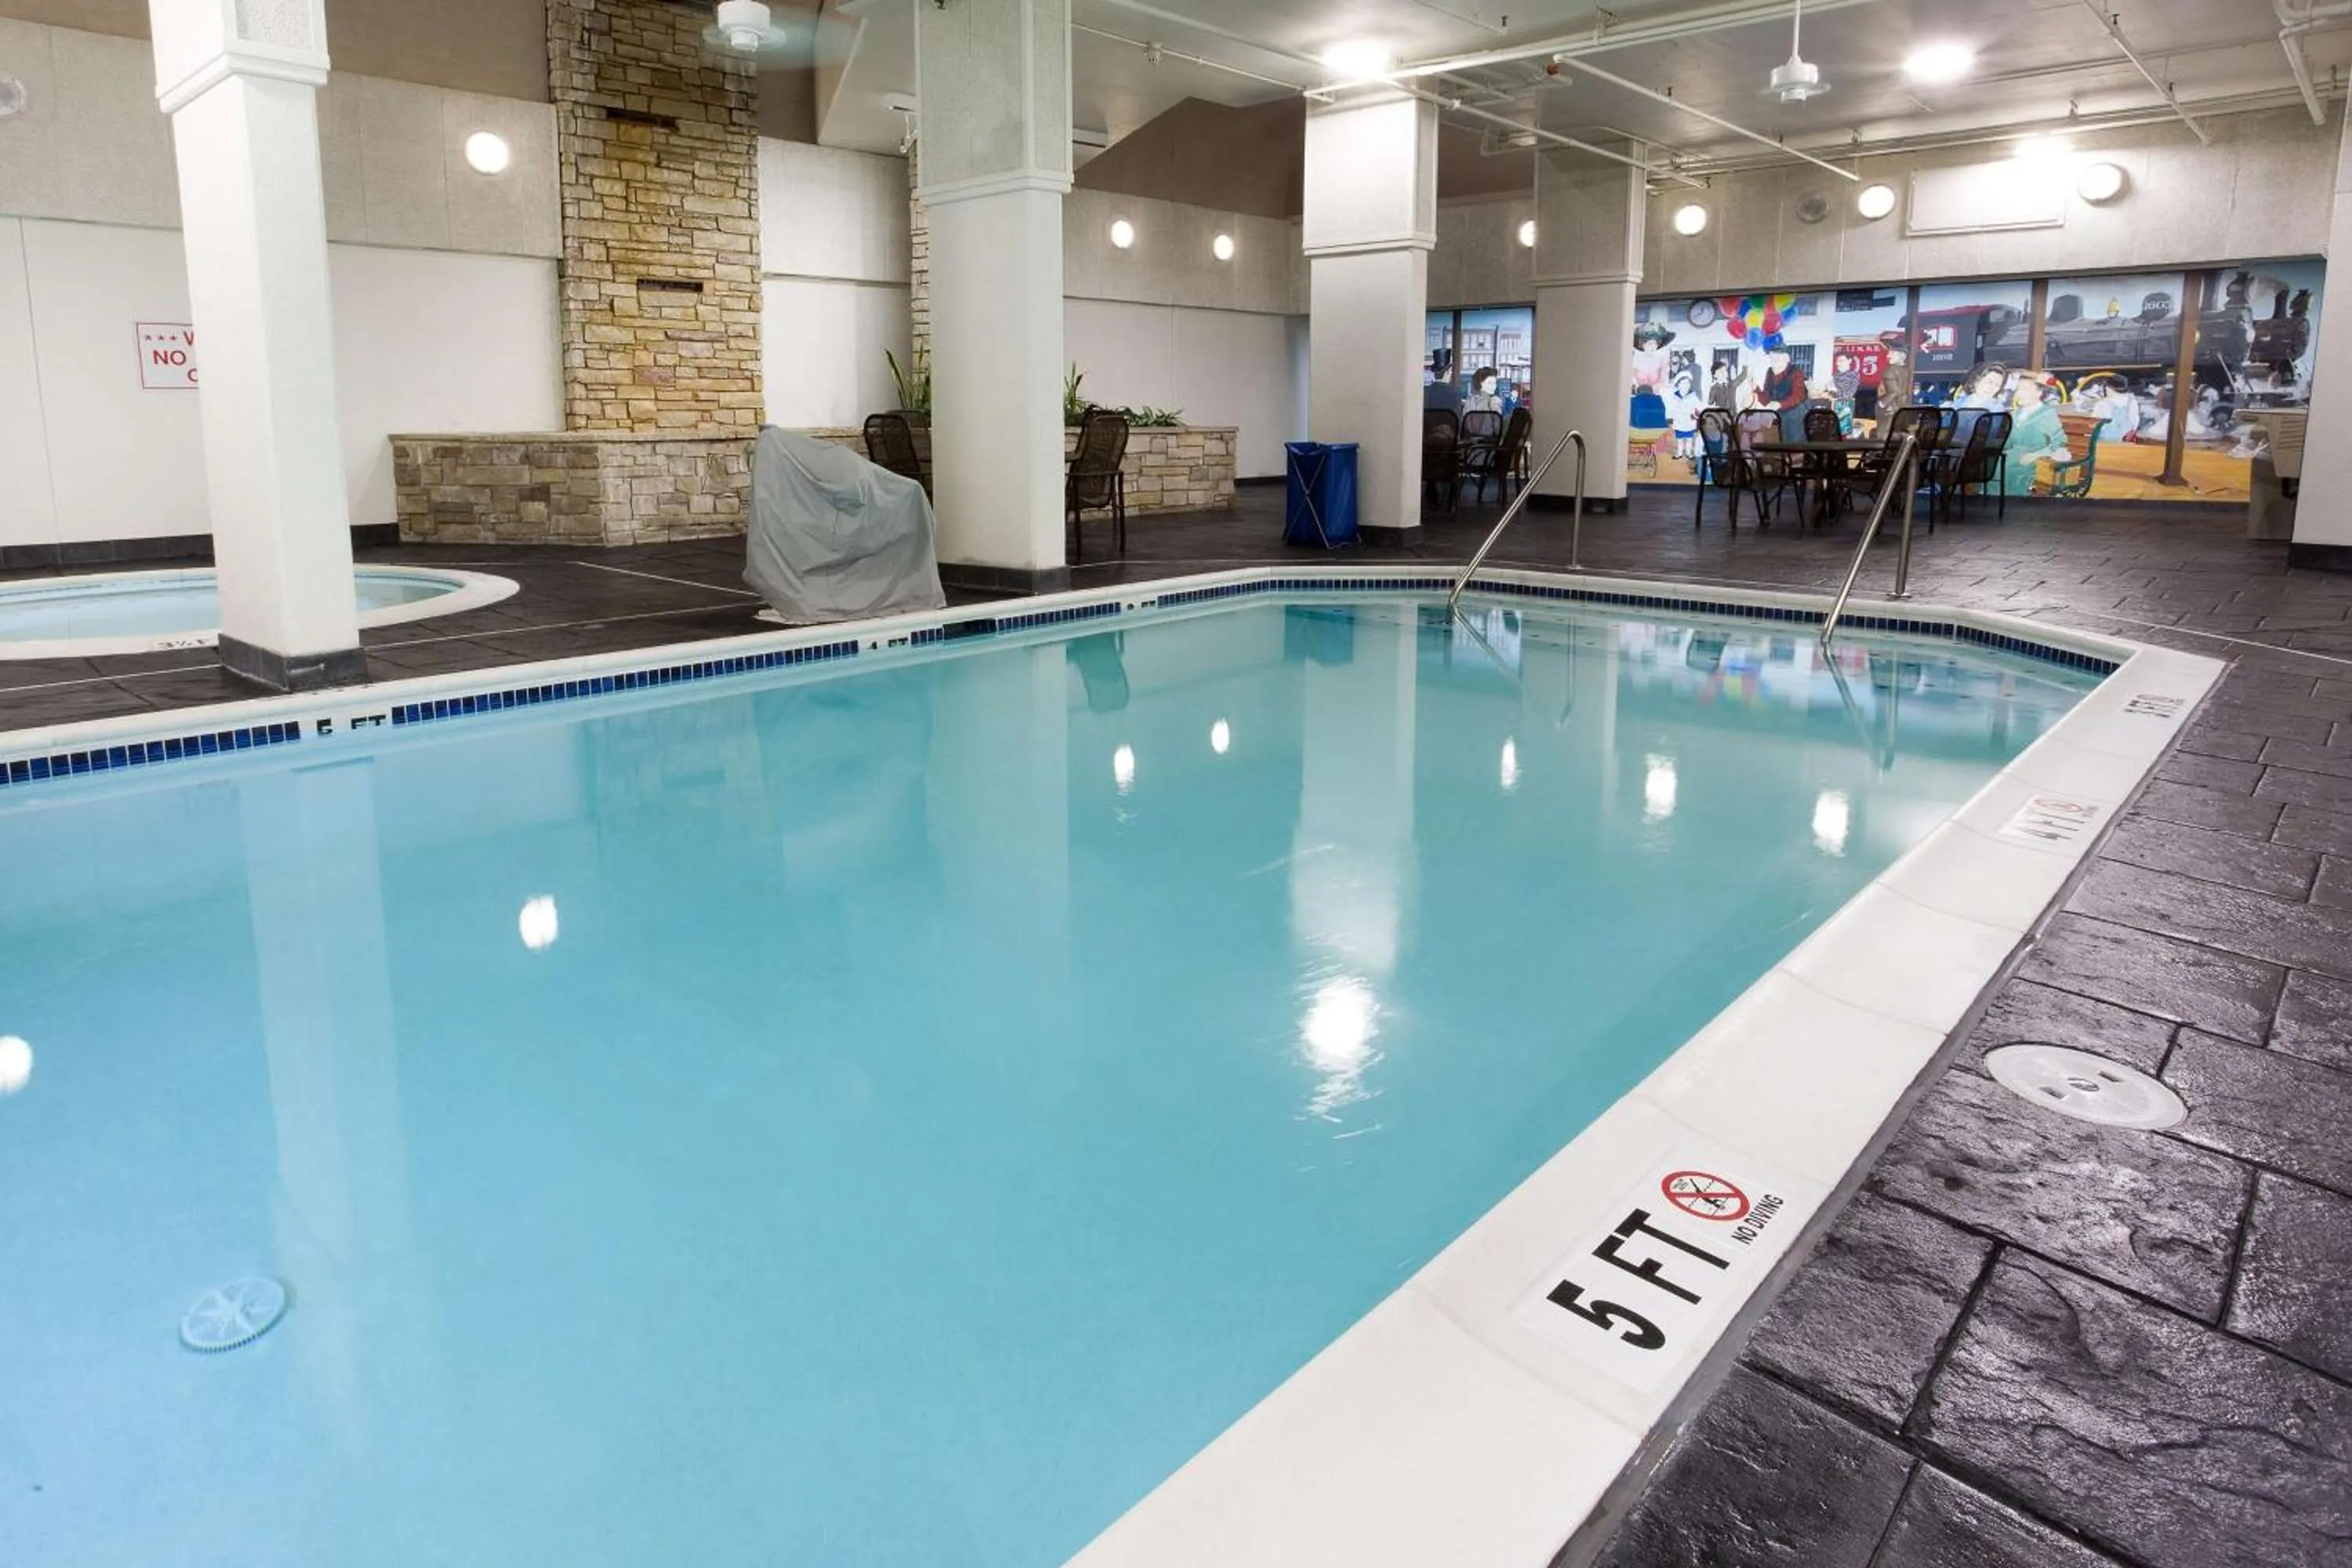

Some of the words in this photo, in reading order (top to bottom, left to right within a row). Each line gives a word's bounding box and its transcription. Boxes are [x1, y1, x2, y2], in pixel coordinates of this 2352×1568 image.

[153, 350, 187, 366] NO
[351, 715, 387, 730] FT
[1744, 1193, 1784, 1230] DIVING
[1731, 1225, 1758, 1246] NO
[1592, 1208, 1730, 1305] FT
[1546, 1279, 1666, 1350] 5
